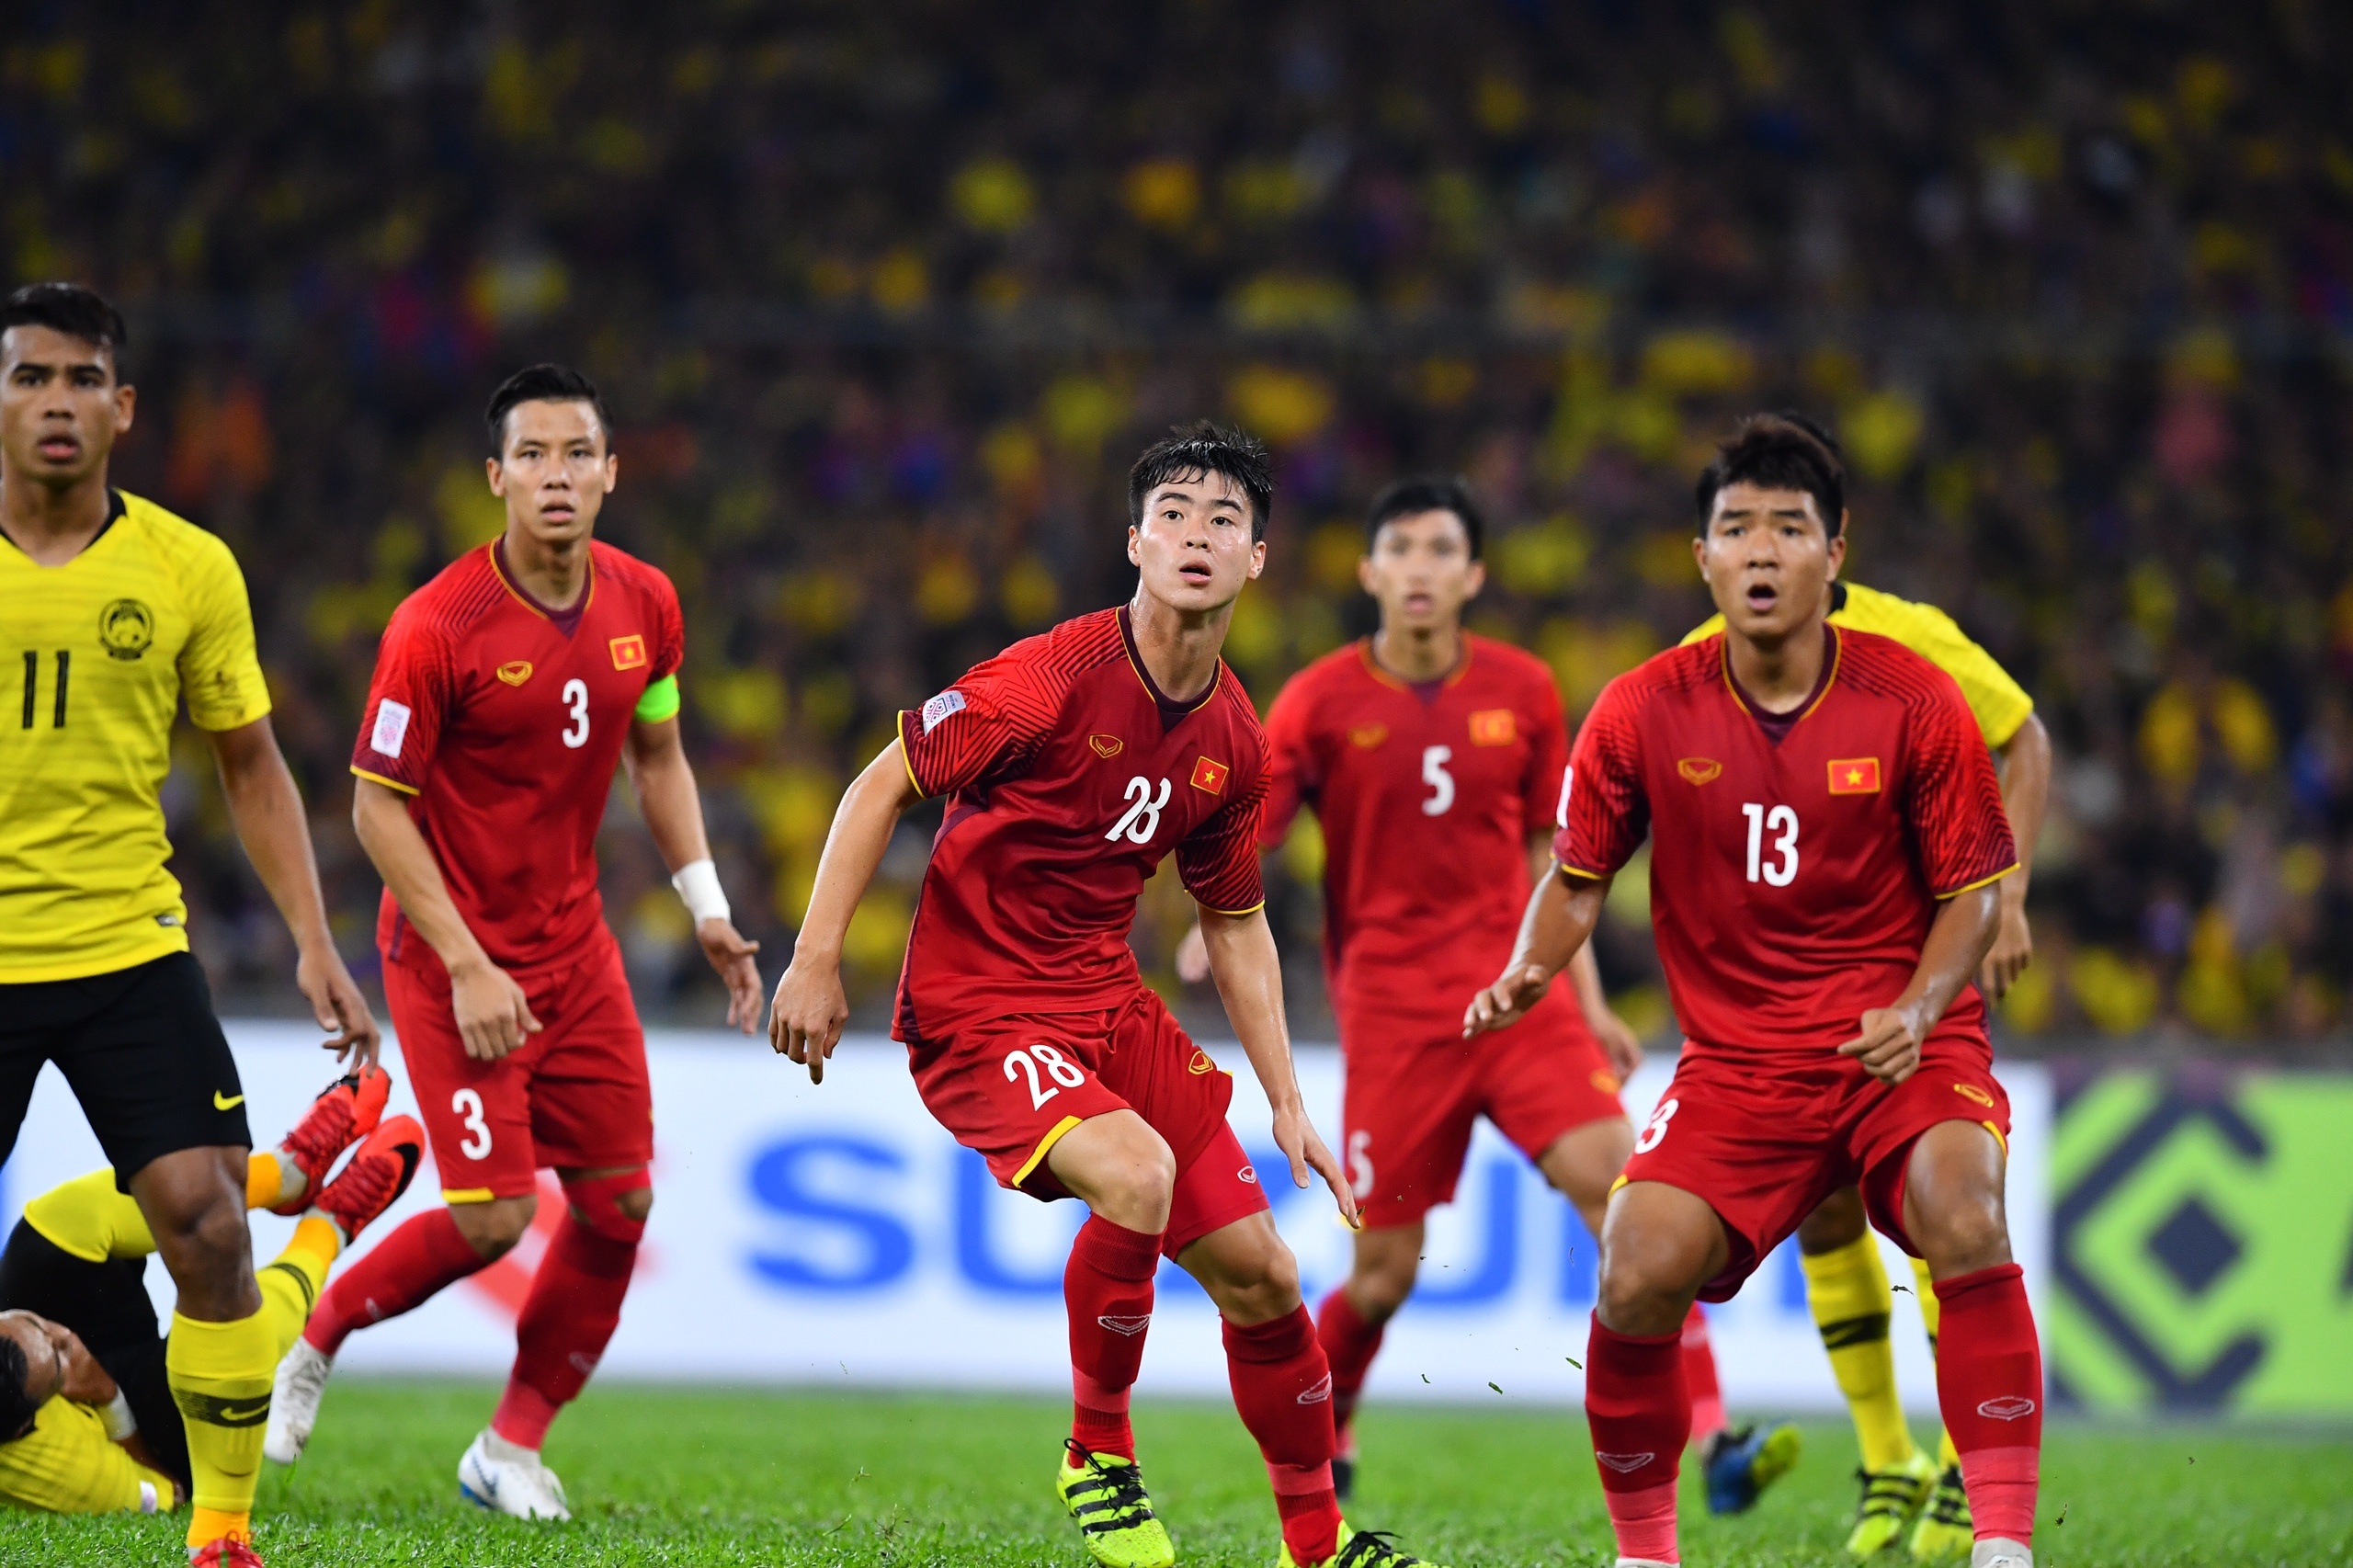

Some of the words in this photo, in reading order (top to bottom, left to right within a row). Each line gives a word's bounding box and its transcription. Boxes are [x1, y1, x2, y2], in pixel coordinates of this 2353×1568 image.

[21, 649, 71, 731] 11
[562, 678, 590, 748] 3
[1104, 776, 1172, 845] 28
[1422, 745, 1455, 815] 5
[1742, 802, 1800, 887] 13
[1003, 1044, 1086, 1112] 28
[451, 1087, 493, 1161] 3
[1634, 1098, 1679, 1155] 3
[1347, 1130, 1375, 1199] 5
